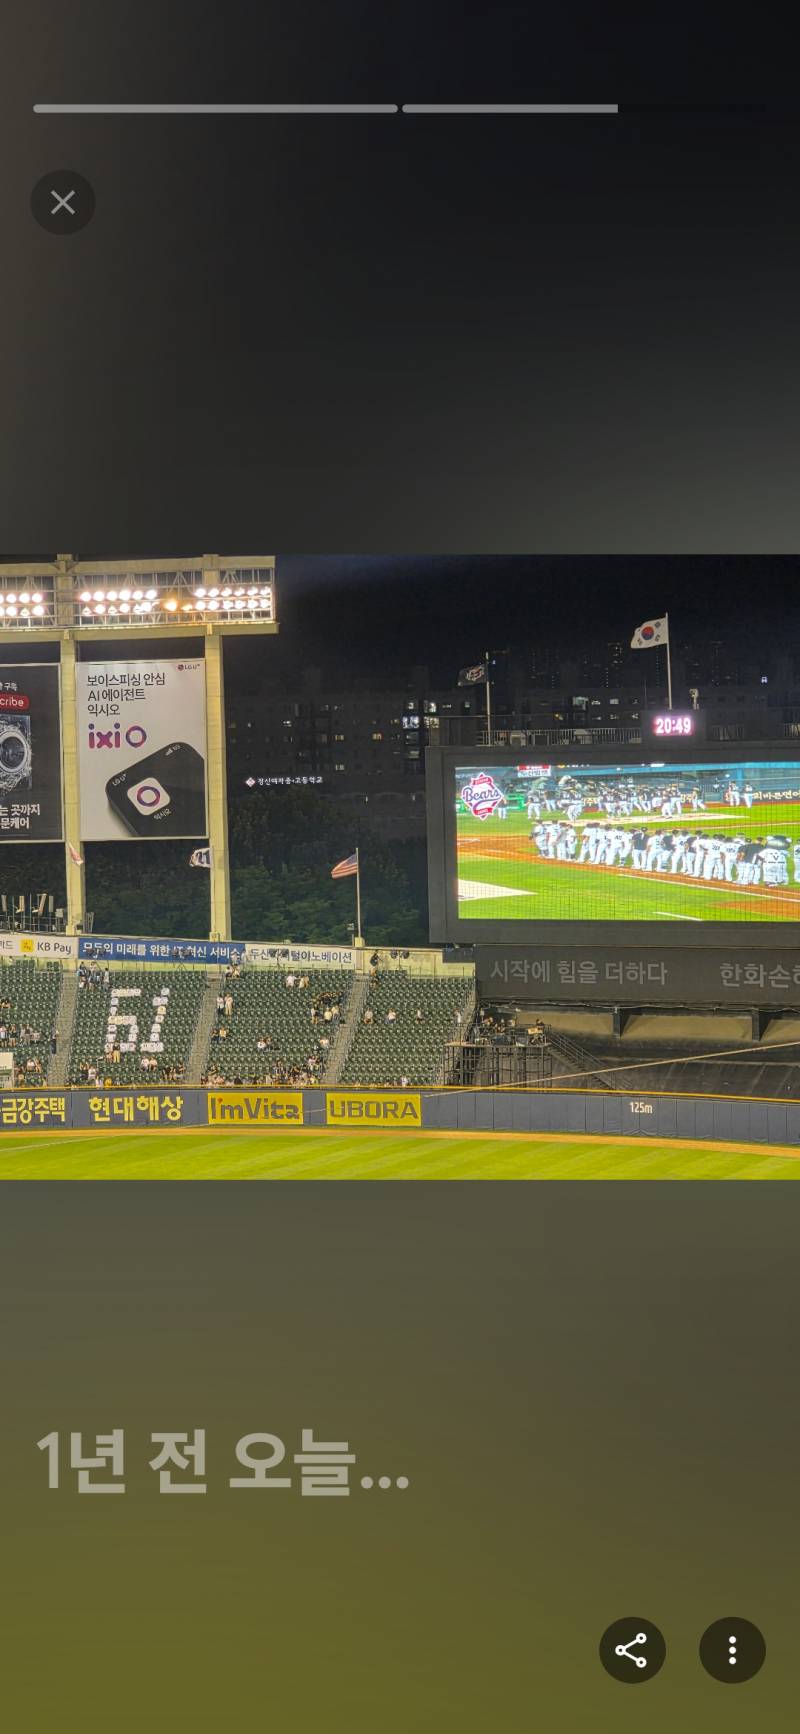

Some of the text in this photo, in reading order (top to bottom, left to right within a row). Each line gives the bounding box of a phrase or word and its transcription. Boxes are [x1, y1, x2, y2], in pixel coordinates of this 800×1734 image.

[87, 672, 165, 687] 보이스피싱 안심
[88, 688, 146, 702] AI 에이전트
[87, 703, 121, 717] 익시오
[655, 717, 692, 734] 20:49
[462, 785, 502, 803] Bears
[11, 803, 40, 816] 곳까지
[153, 807, 172, 820] 익시오
[0, 816, 30, 829] 문케어
[37, 942, 51, 951] KB
[53, 942, 72, 954] Pay
[116, 942, 147, 957] 미래를
[149, 944, 170, 957] 위한
[210, 946, 240, 961] 서비스
[249, 947, 353, 964] 두산털이노베이션
[490, 959, 550, 983] 시작에
[556, 959, 600, 984] 힘을
[605, 960, 668, 986] 더하다
[2, 1097, 66, 1124] 금강주택
[89, 1095, 184, 1122] 현대해상
[329, 1099, 418, 1119] UBORA
[629, 1101, 653, 1114] 125m
